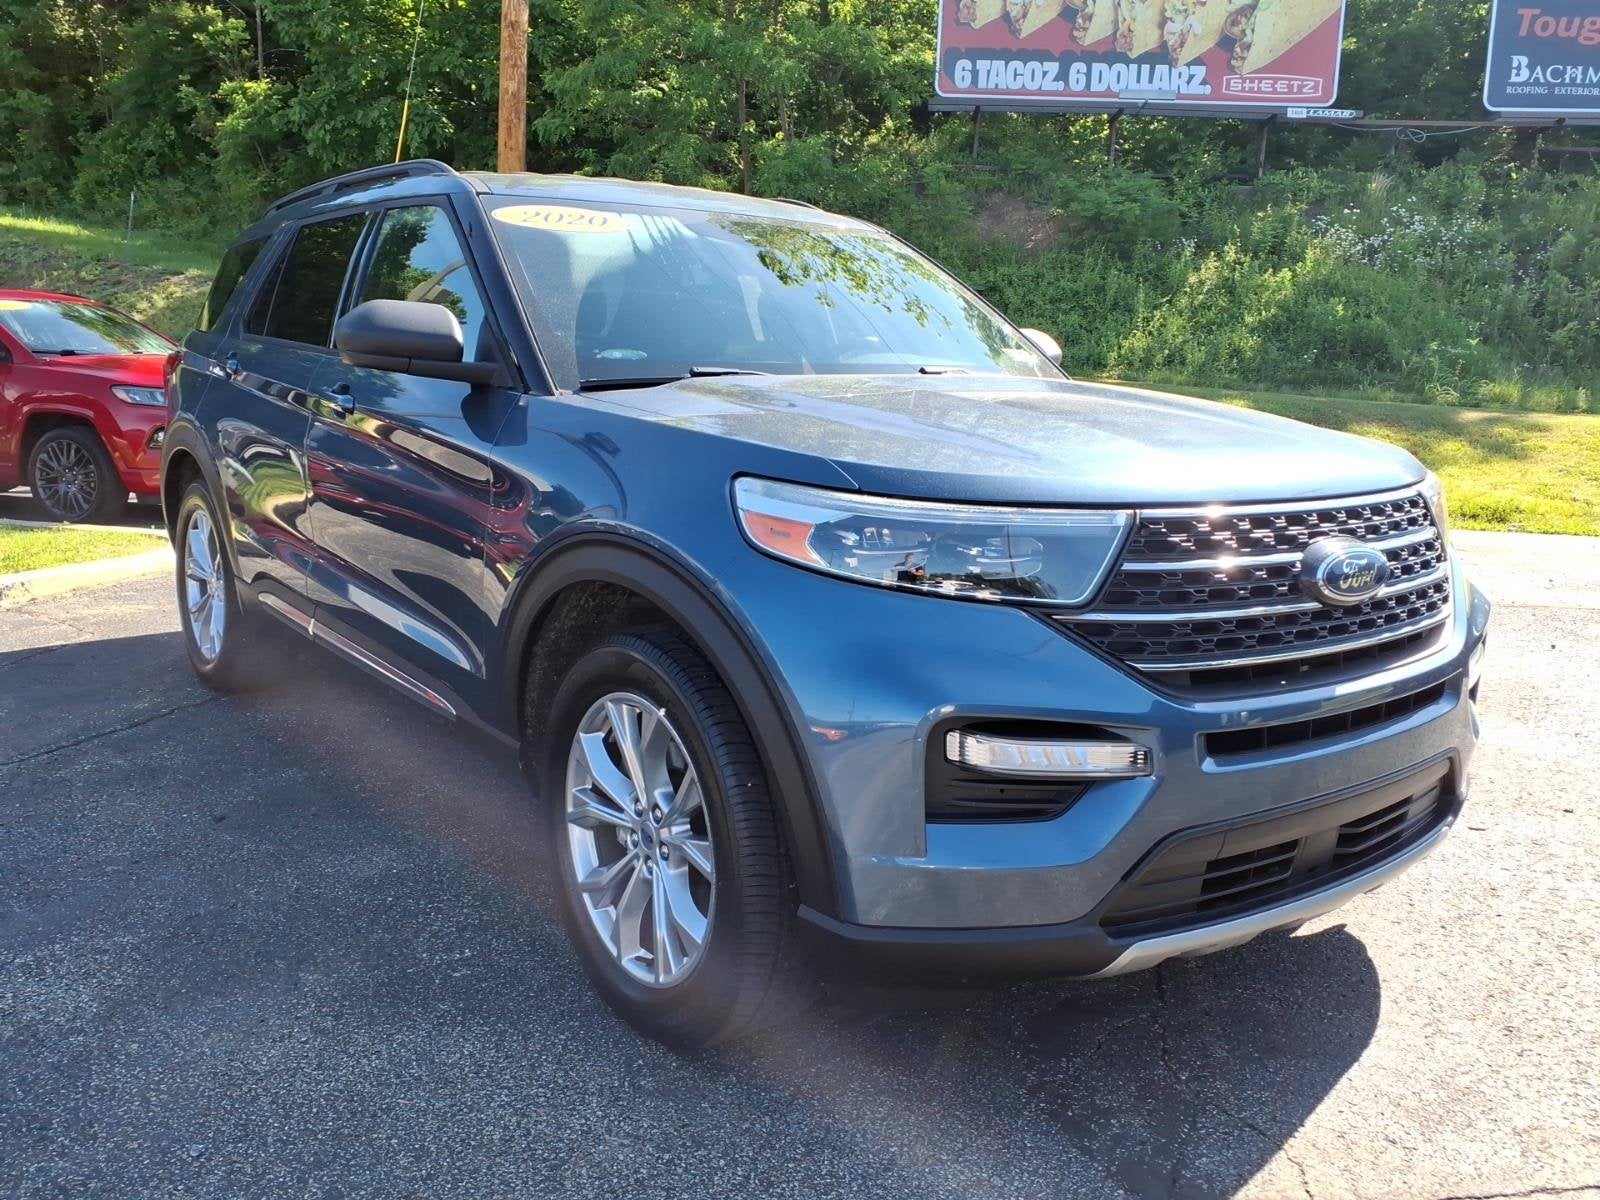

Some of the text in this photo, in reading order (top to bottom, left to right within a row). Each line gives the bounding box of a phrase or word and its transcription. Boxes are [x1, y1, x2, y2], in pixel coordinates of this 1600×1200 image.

[954, 58, 1212, 95] 6 TACOZ. 6 DOLLARZ.
[1229, 79, 1316, 93] SHEETZ
[1506, 85, 1549, 95] ROOFING
[1309, 109, 1350, 117] LAMAR
[522, 211, 608, 226] 2020
[1340, 559, 1377, 589] Ford
